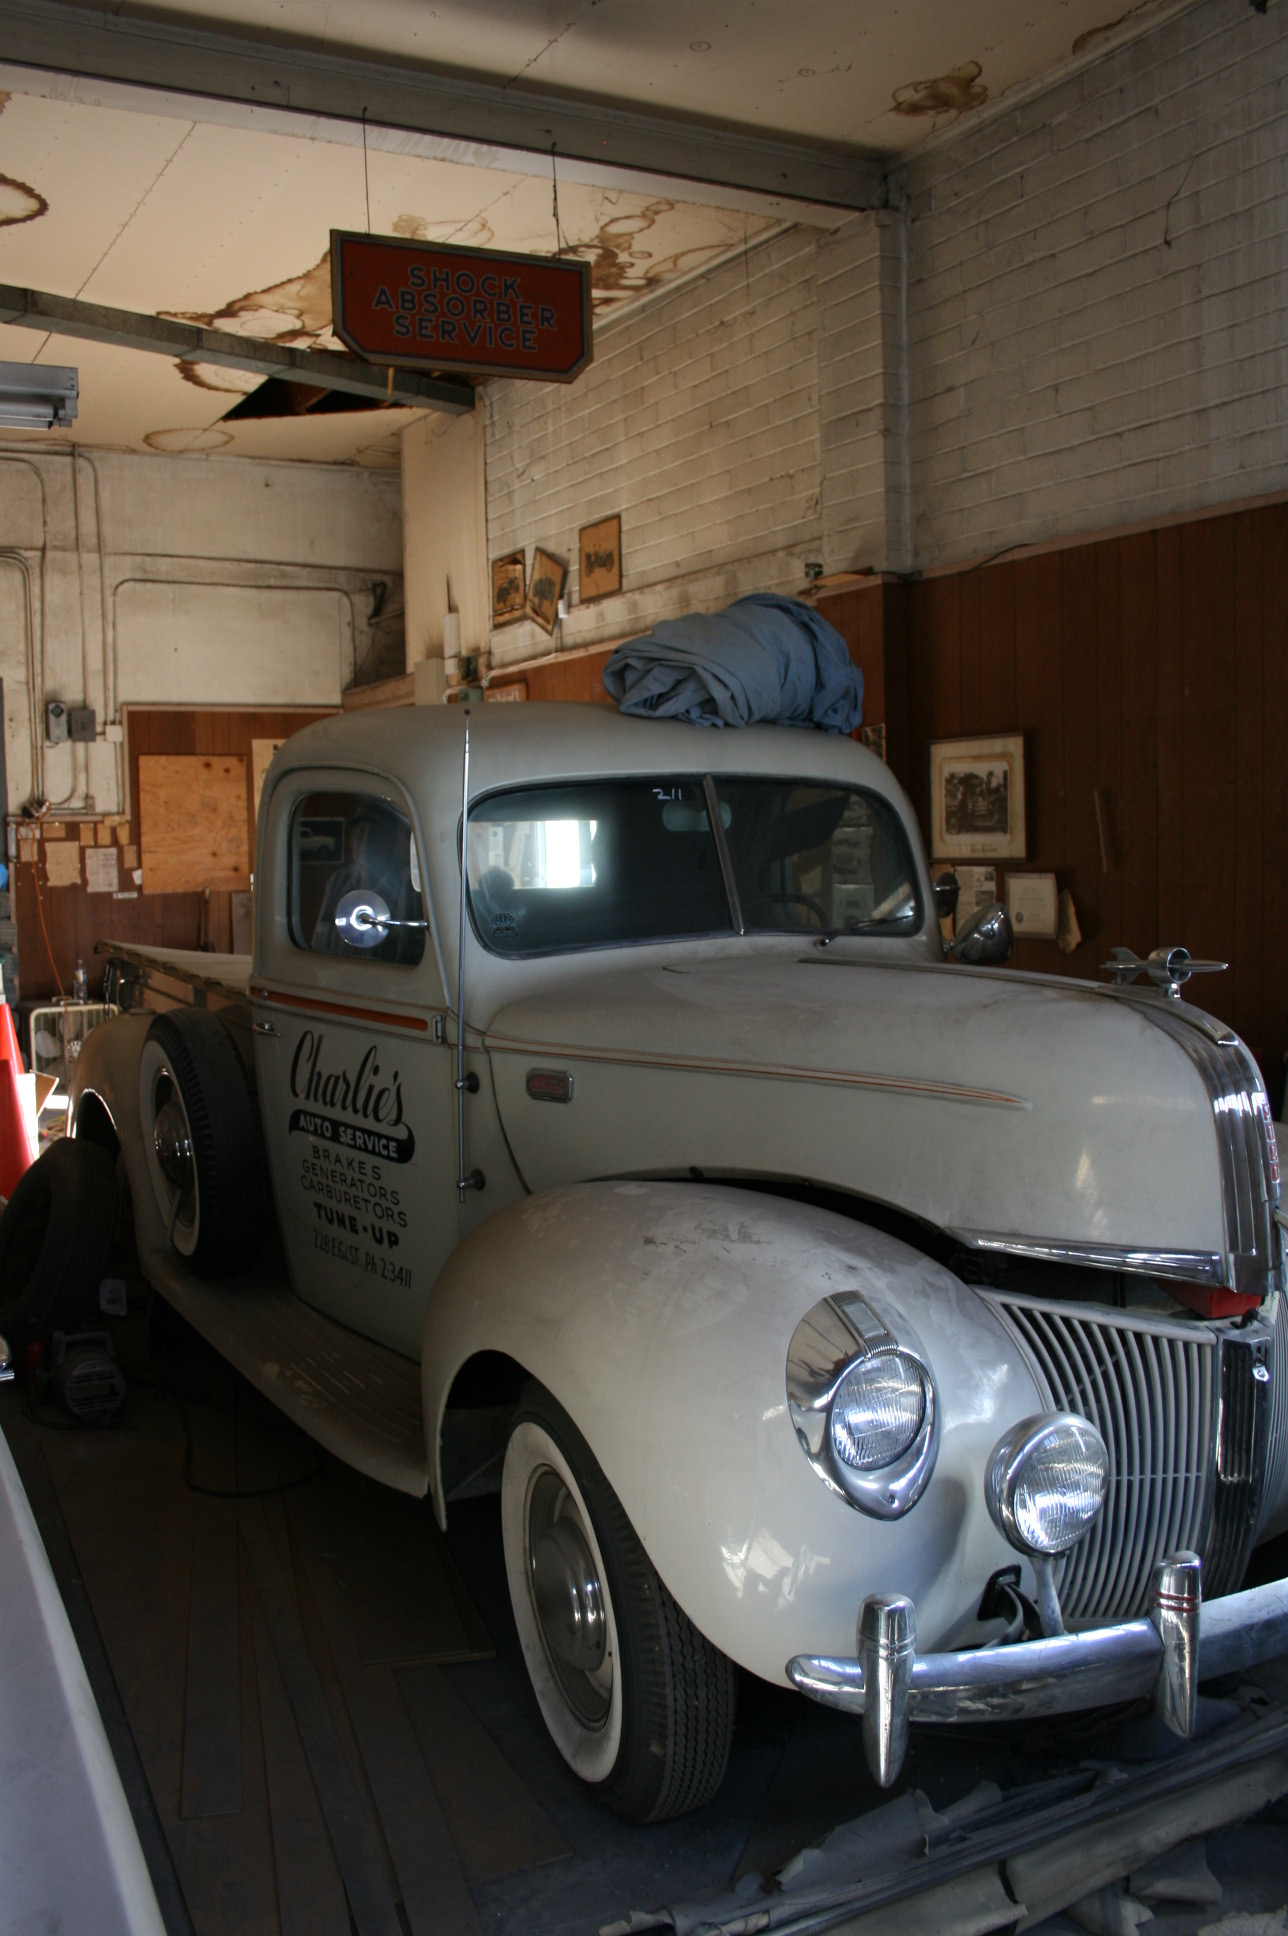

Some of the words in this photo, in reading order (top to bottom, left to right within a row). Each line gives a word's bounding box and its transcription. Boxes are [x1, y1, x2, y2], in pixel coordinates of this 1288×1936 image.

[408, 264, 521, 300] SHOCK
[372, 286, 557, 330] ABSORBER
[394, 313, 538, 352] SERVICE
[651, 787, 683, 800] 211
[290, 1029, 403, 1127] Charlie's
[298, 1112, 332, 1139] AUTO
[338, 1125, 399, 1159] SERVICE
[302, 1159, 400, 1206] GENERATORS
[312, 1144, 381, 1181] BRAKES
[300, 1175, 408, 1228] CARBURETORS
